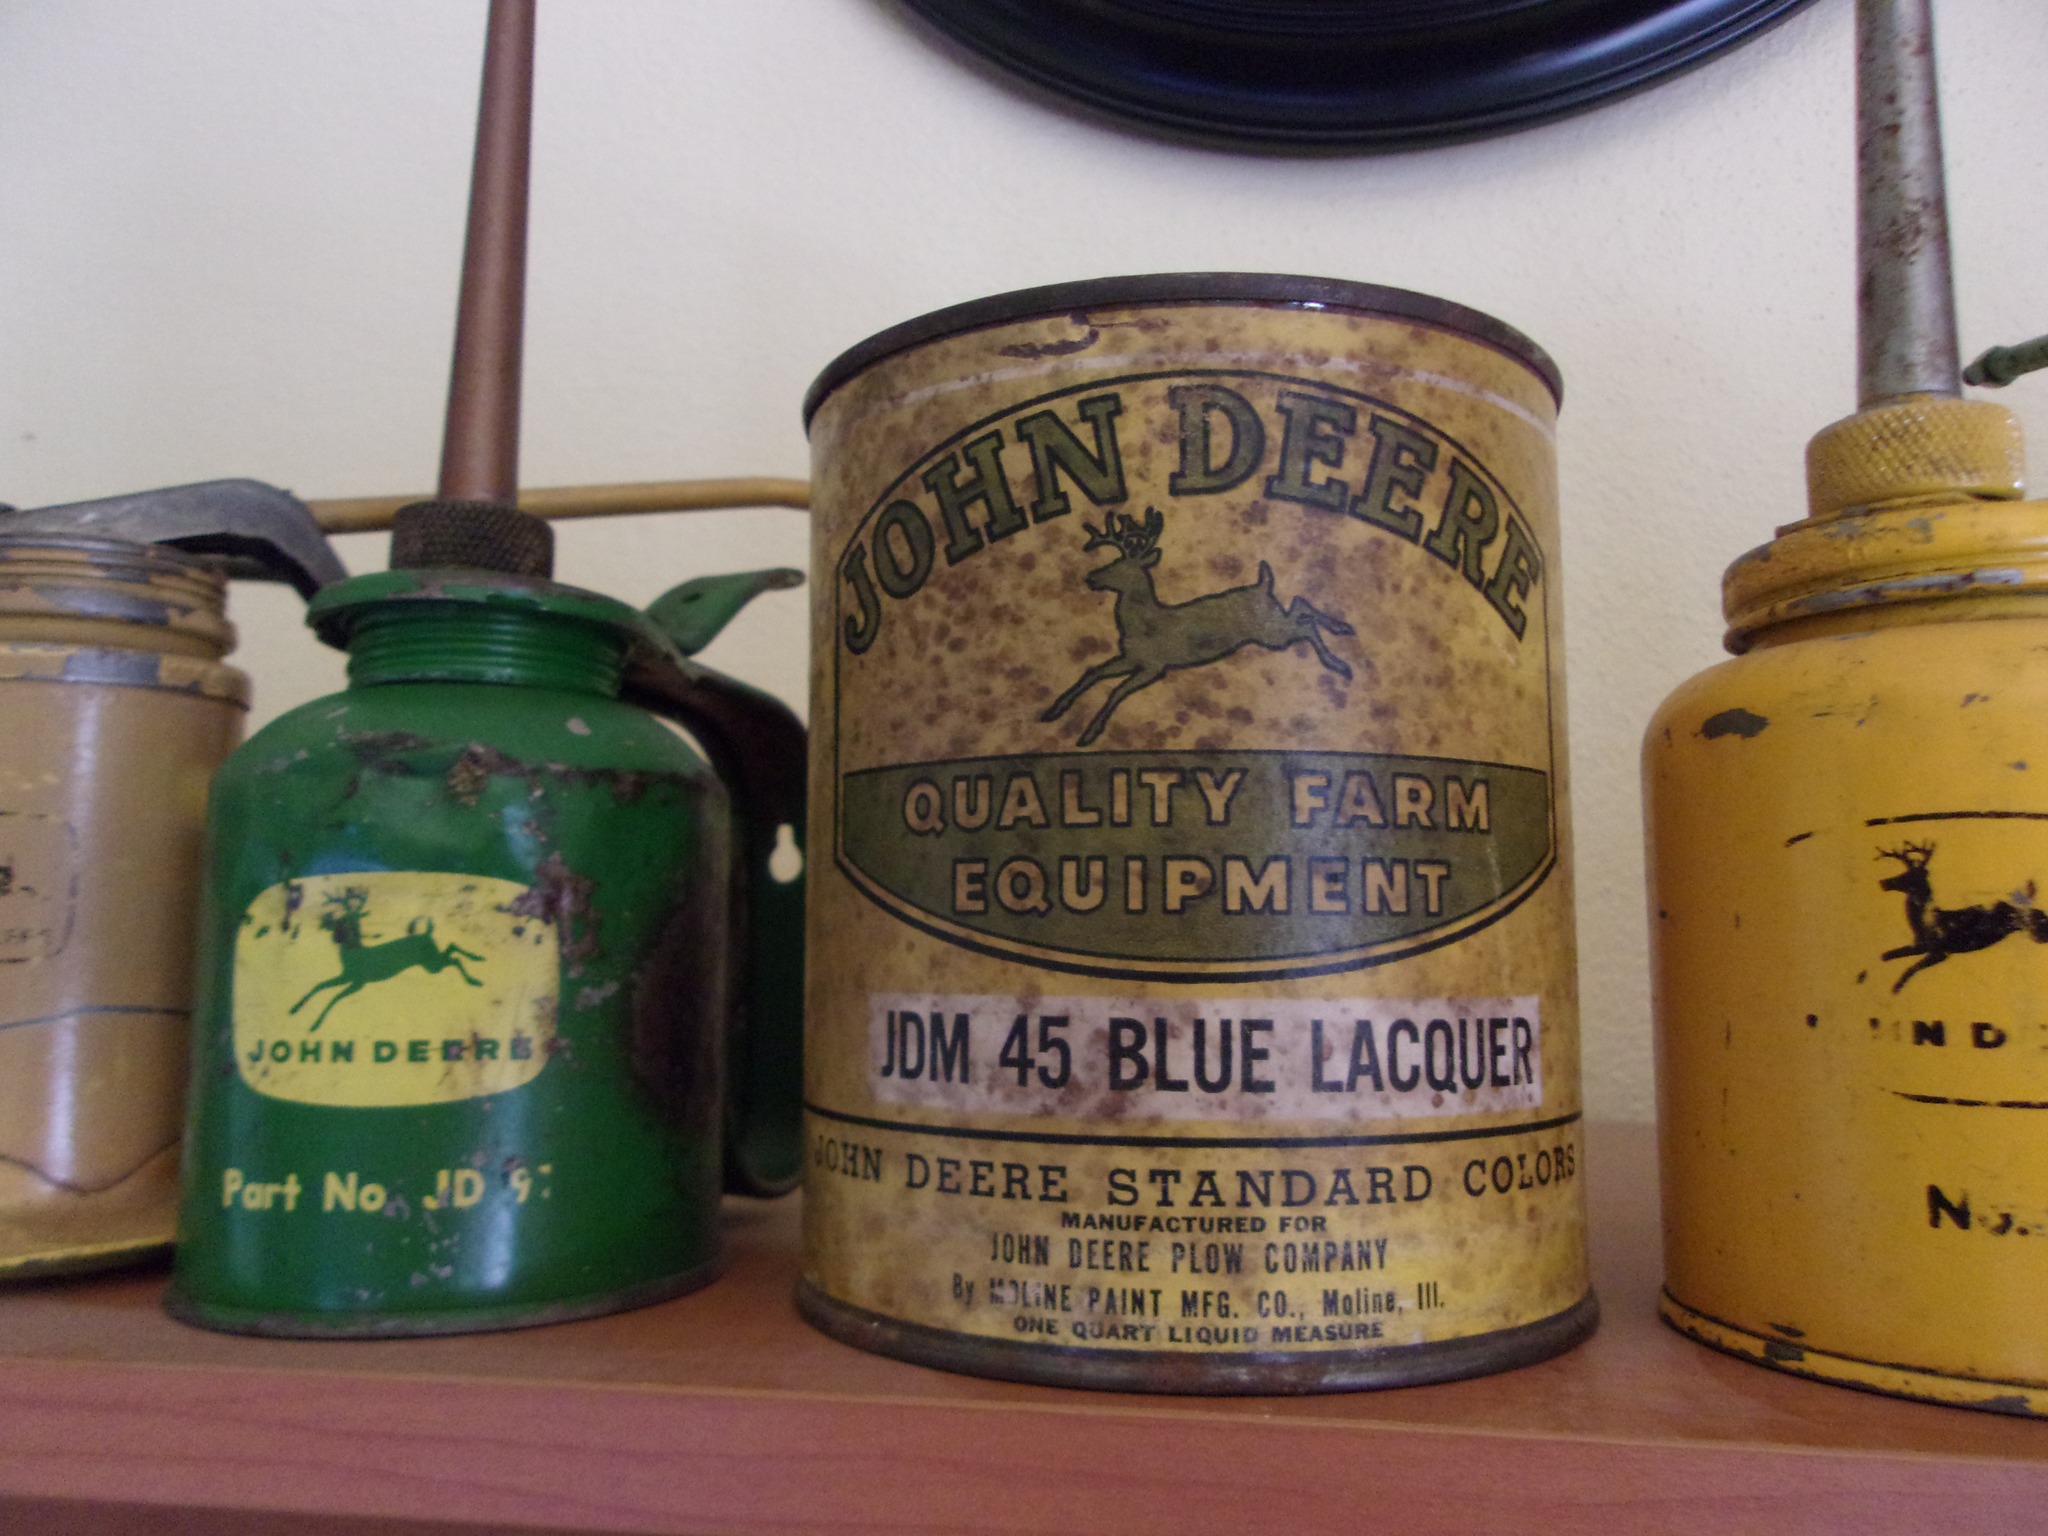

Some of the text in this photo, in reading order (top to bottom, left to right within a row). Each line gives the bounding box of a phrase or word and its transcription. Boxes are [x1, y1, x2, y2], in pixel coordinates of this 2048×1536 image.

[844, 384, 1543, 655] JOHN DEERE
[902, 768, 1492, 838] QUALITY FARM
[952, 854, 1452, 917] EQUIPMENT
[248, 1037, 534, 1064] JOHN DEERE
[881, 1010, 1534, 1094] JDM 45 BLUE LACQUER
[222, 1168, 302, 1212] Part
[422, 1168, 486, 1211] JD
[814, 1135, 1576, 1208] JOHN DEERE STANDARD COLORS
[1061, 1212, 1327, 1233] MANUFACTURED FOR
[991, 1232, 1388, 1274] JOHN DEERE PLOW COMPANY
[953, 1272, 975, 1305] By
[1088, 1286, 1162, 1318] PAINT
[1181, 1290, 1239, 1319] MFG.
[1257, 1290, 1305, 1321] CO.,
[1322, 1287, 1404, 1316] Moline,
[1013, 1315, 1384, 1346] ONE QUART LIQUID MEASURE
